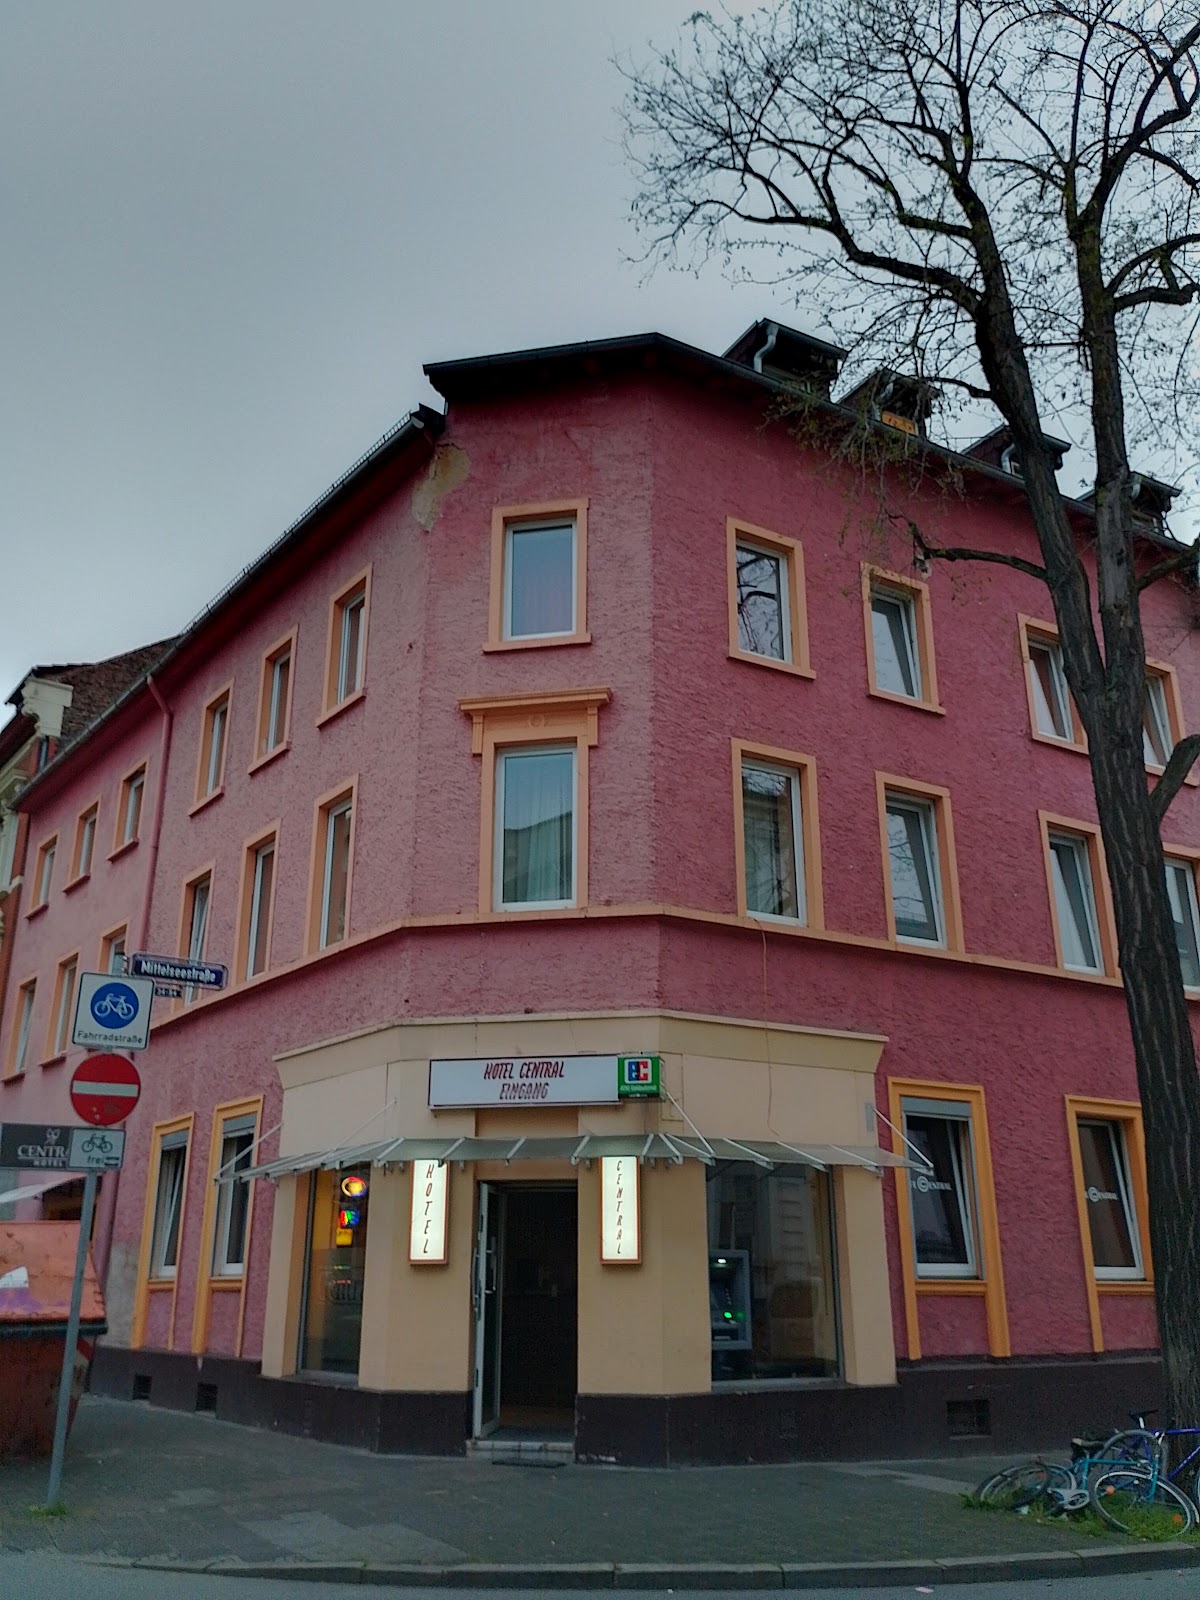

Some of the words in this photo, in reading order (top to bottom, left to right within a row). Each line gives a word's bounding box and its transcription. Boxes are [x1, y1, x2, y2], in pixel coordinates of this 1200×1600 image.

[78, 1030, 143, 1044] Fahrradstraße
[483, 1062, 514, 1080] HOTEL
[519, 1060, 564, 1079] CENTRAL
[499, 1082, 550, 1100] EINGANG
[423, 1163, 435, 1254] HOTEL
[615, 1159, 624, 1254] CENTRAL
